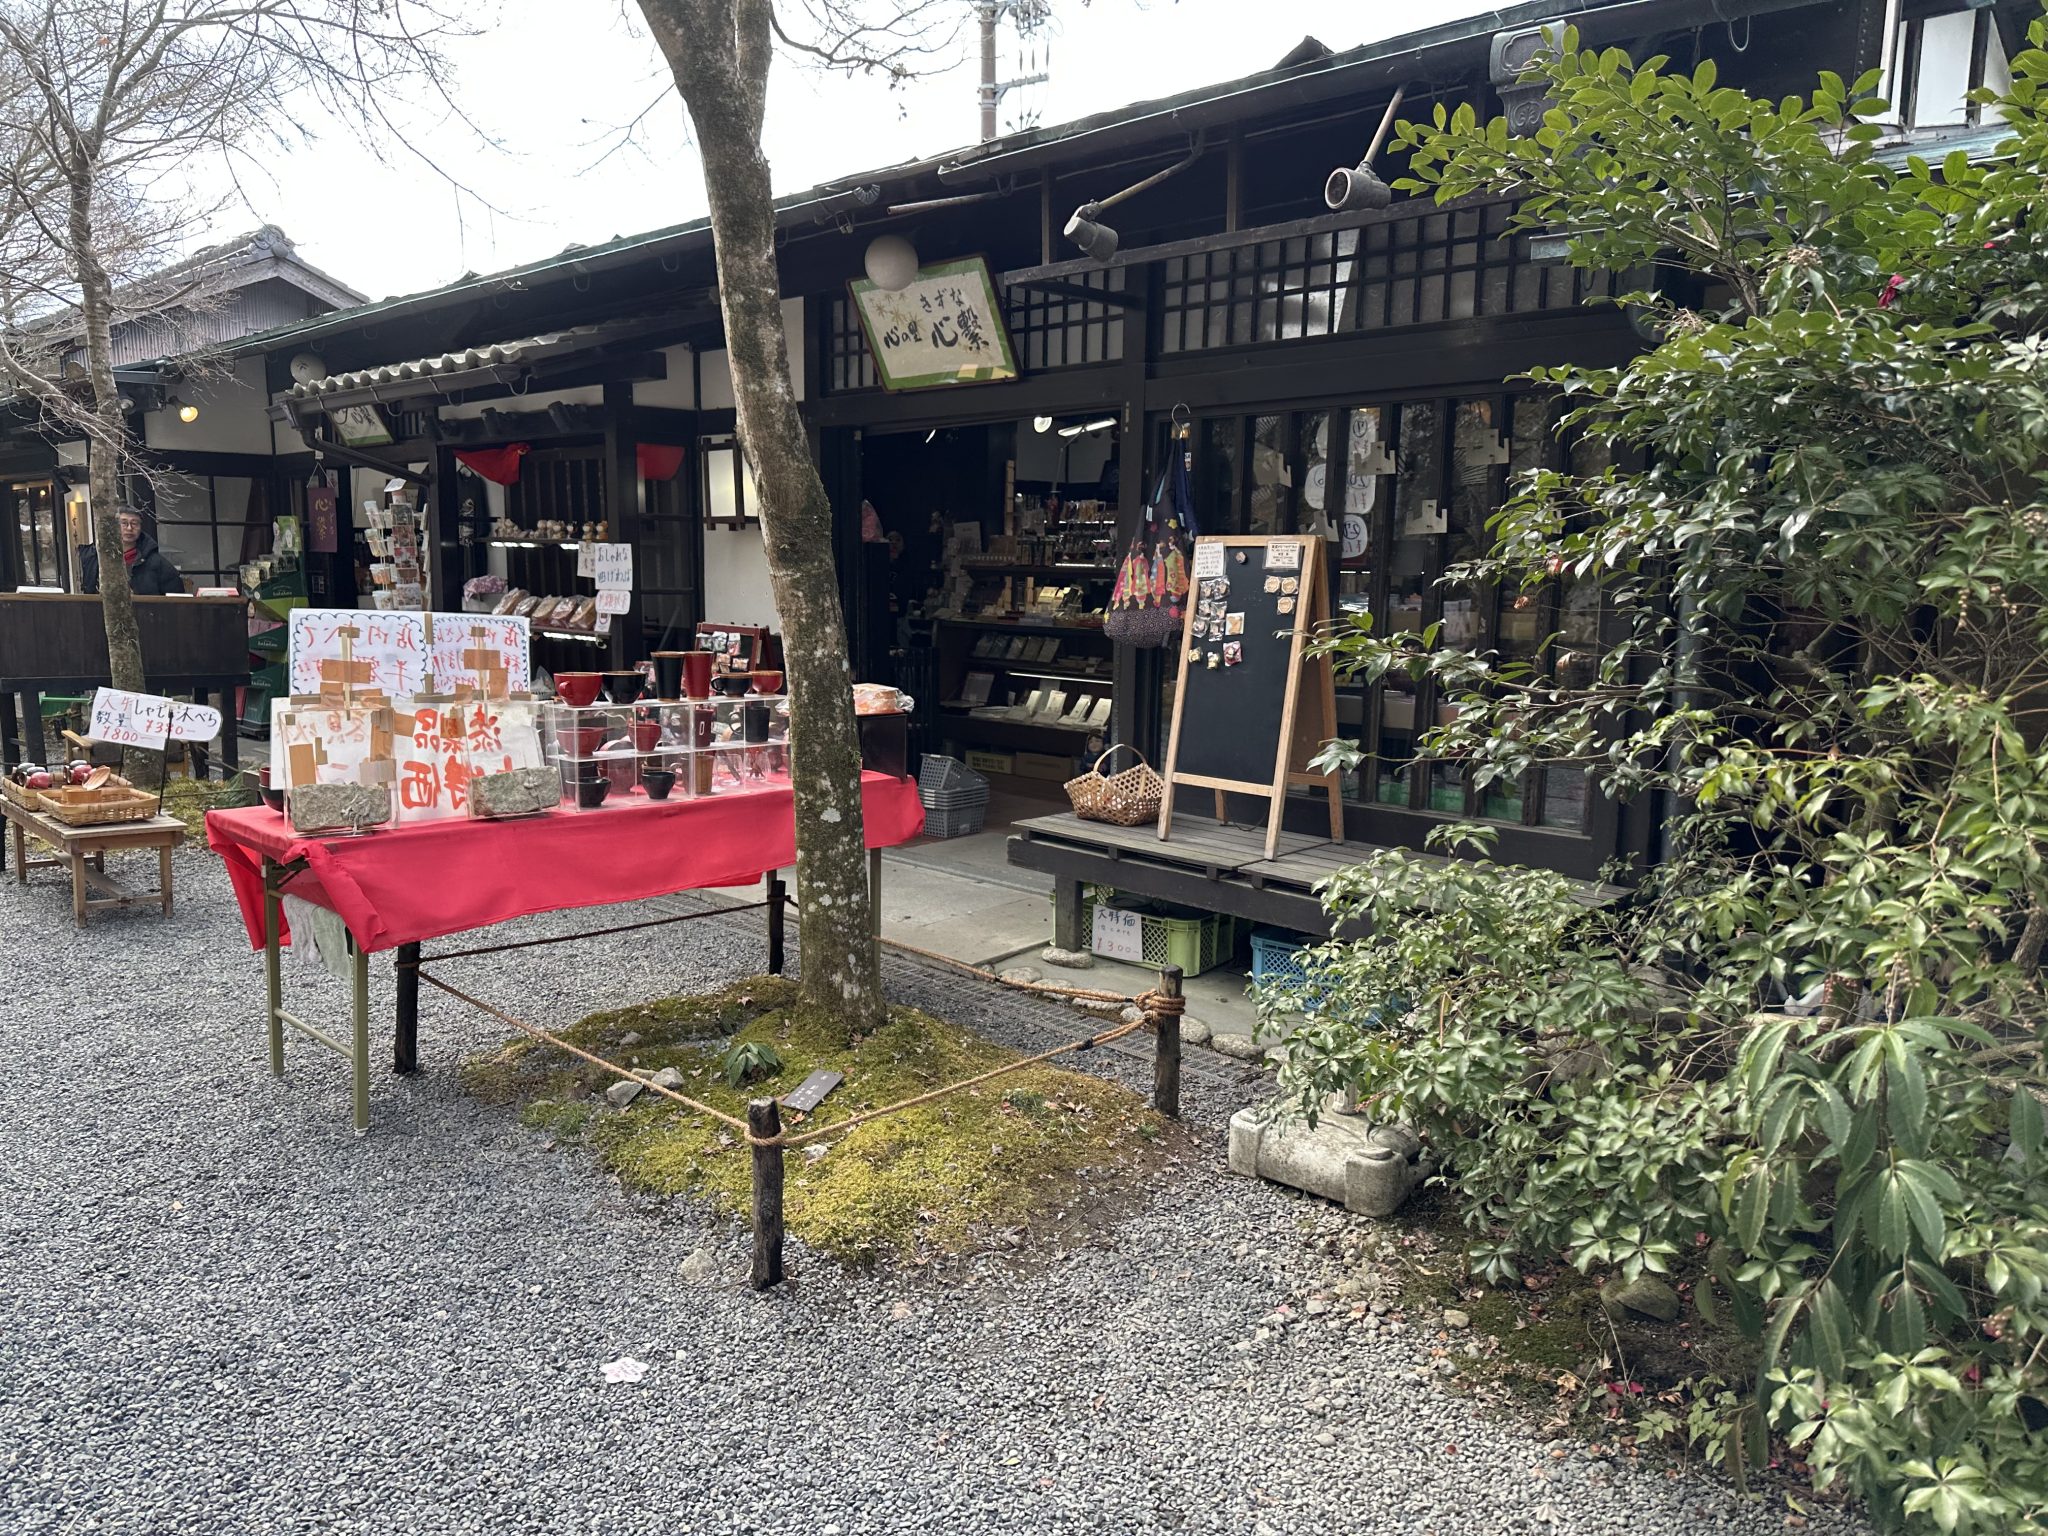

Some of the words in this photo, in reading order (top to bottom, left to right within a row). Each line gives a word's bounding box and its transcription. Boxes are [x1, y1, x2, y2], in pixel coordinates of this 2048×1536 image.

[919, 287, 965, 314] きずな
[884, 319, 923, 350] 心の里
[1097, 908, 1136, 927] 大特価
